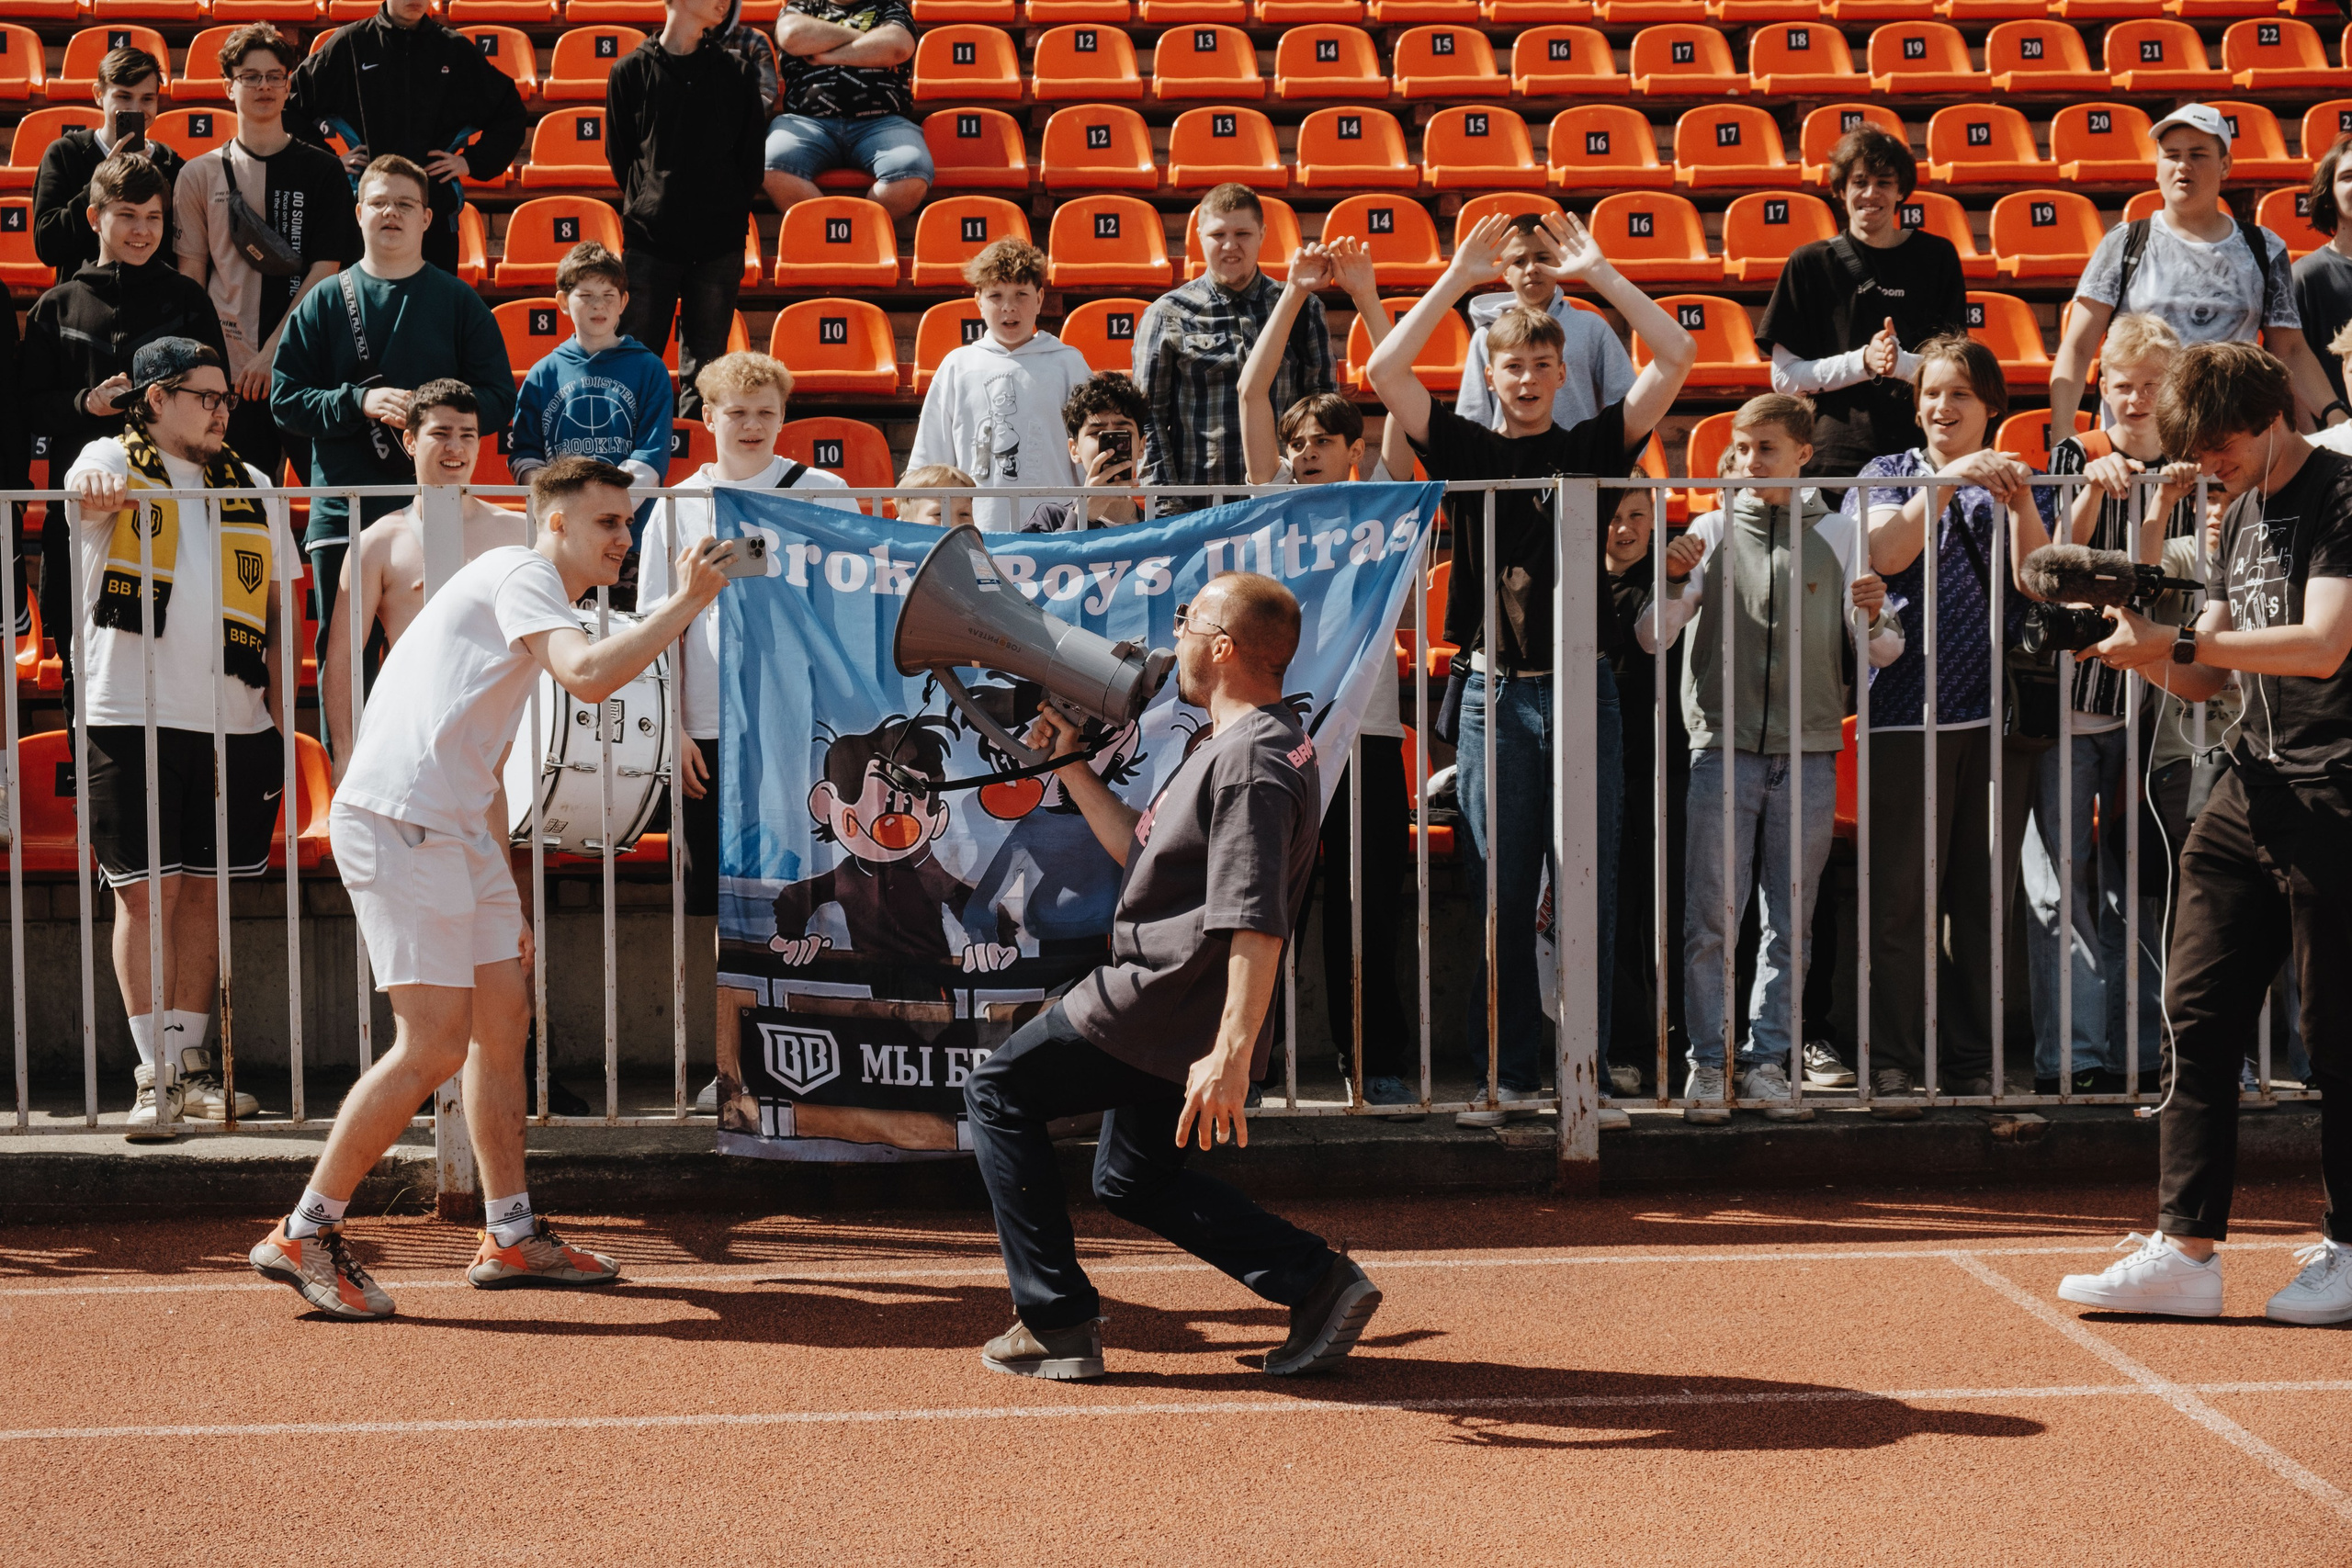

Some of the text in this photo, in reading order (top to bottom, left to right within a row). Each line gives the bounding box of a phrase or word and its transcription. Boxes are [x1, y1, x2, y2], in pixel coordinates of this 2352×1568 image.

[1079, 34, 1094, 49] 12
[1198, 34, 1214, 48] 13
[1791, 33, 1807, 47] 18
[2261, 28, 2278, 41] 22
[114, 36, 124, 49] 4
[482, 39, 491, 52] 7
[602, 39, 611, 53] 8
[1436, 38, 1452, 51] 15
[1553, 43, 1568, 57] 16
[1907, 41, 1923, 55] 19
[2024, 42, 2041, 55] 20
[957, 47, 971, 61] 11
[1320, 43, 1336, 58] 14
[1676, 46, 1690, 60] 17
[2143, 44, 2159, 58] 21
[196, 118, 206, 134] 5
[319, 120, 329, 134] 6
[583, 121, 594, 136] 8
[962, 119, 977, 133] 11
[1216, 118, 1233, 133] 13
[1341, 120, 1359, 135] 14
[1469, 118, 1486, 132] 15
[2091, 115, 2109, 130] 20
[1091, 130, 1107, 144] 12
[1721, 127, 1736, 142] 17
[1972, 127, 1988, 141] 19
[1589, 136, 1607, 151] 16
[282, 190, 290, 210] Focus
[7, 211, 19, 227] 4
[282, 211, 288, 220] on
[1769, 204, 1785, 220] 17
[1904, 209, 1921, 223] 18
[2035, 207, 2053, 222] 19
[1099, 218, 1116, 233] 12
[1372, 213, 1390, 229] 14
[1633, 218, 1650, 232] 16
[290, 209, 303, 254] SOMETH
[561, 222, 571, 237] 8
[831, 223, 848, 239] 10
[967, 221, 982, 237] 11
[345, 286, 354, 299] FILA
[348, 300, 356, 316] FILA
[352, 317, 361, 333] FILA
[537, 314, 548, 330] 8
[1681, 310, 1701, 325] 16
[824, 322, 843, 339] 10
[965, 323, 984, 340] 11
[1112, 318, 1131, 334] 12
[356, 335, 366, 354] FILA
[541, 376, 639, 436] SPORT DISTRI
[35, 436, 47, 455] 5
[670, 435, 681, 452] 9
[819, 446, 839, 463] 10
[739, 505, 1420, 616] Brok Boys Ultras
[107, 579, 131, 596] BB
[230, 627, 263, 653] BB FC
[859, 1043, 933, 1088] МЫ
